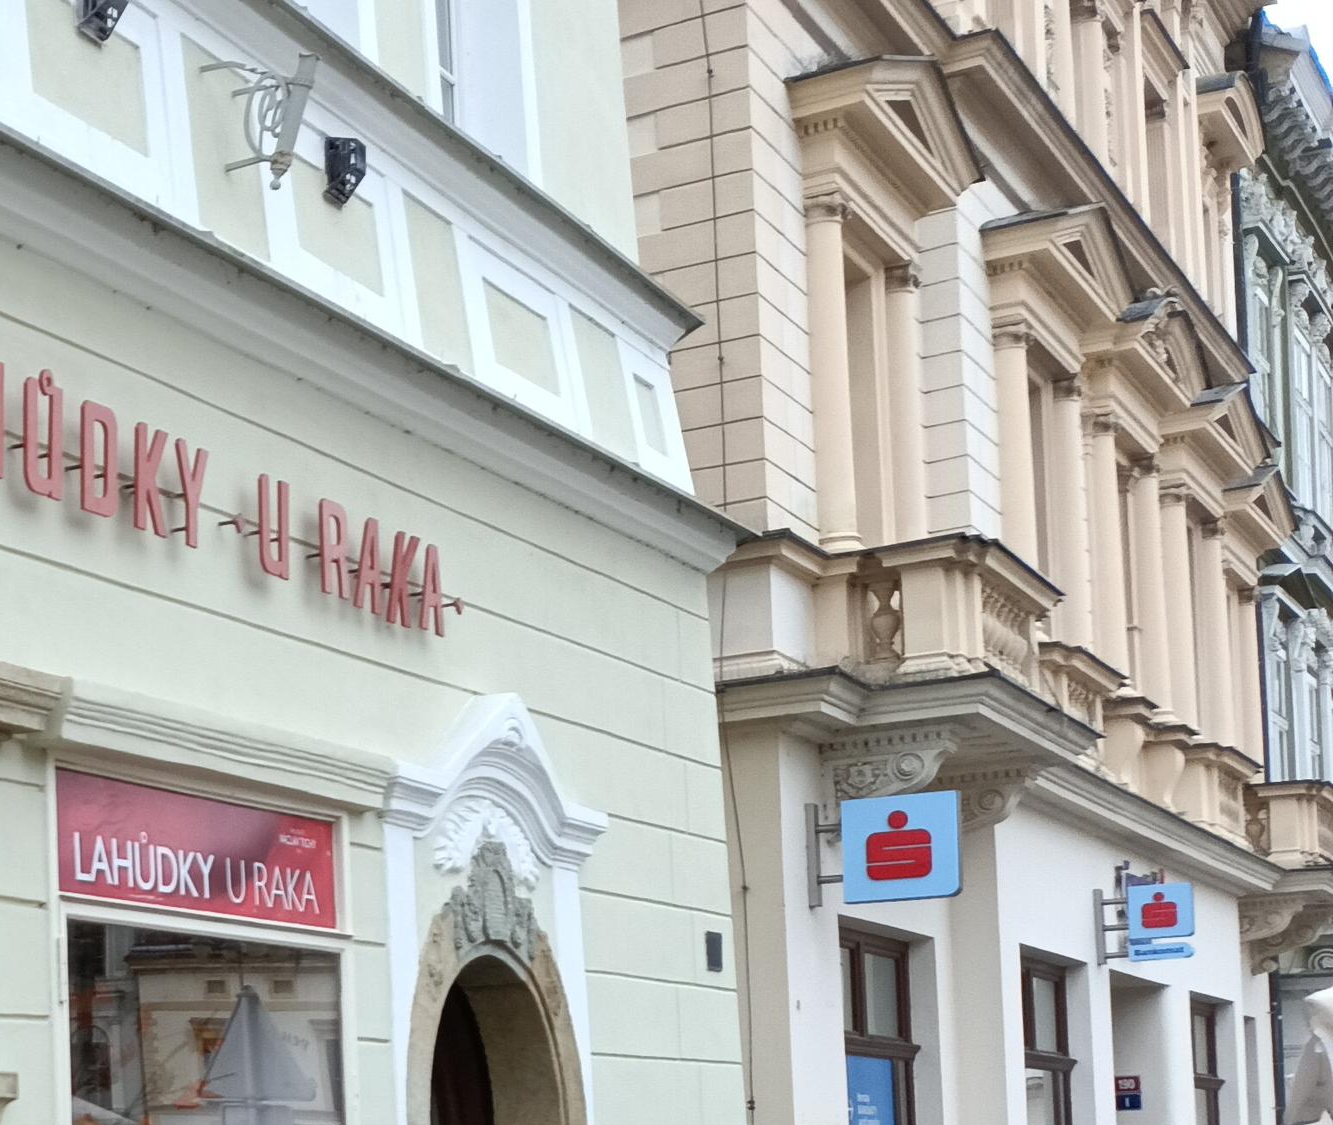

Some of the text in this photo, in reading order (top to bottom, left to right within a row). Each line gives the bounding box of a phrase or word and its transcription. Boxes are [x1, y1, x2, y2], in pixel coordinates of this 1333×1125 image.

[257, 472, 291, 581] U
[318, 497, 446, 638] RAKA
[73, 831, 320, 915] LAHŮDKY U RAKA
